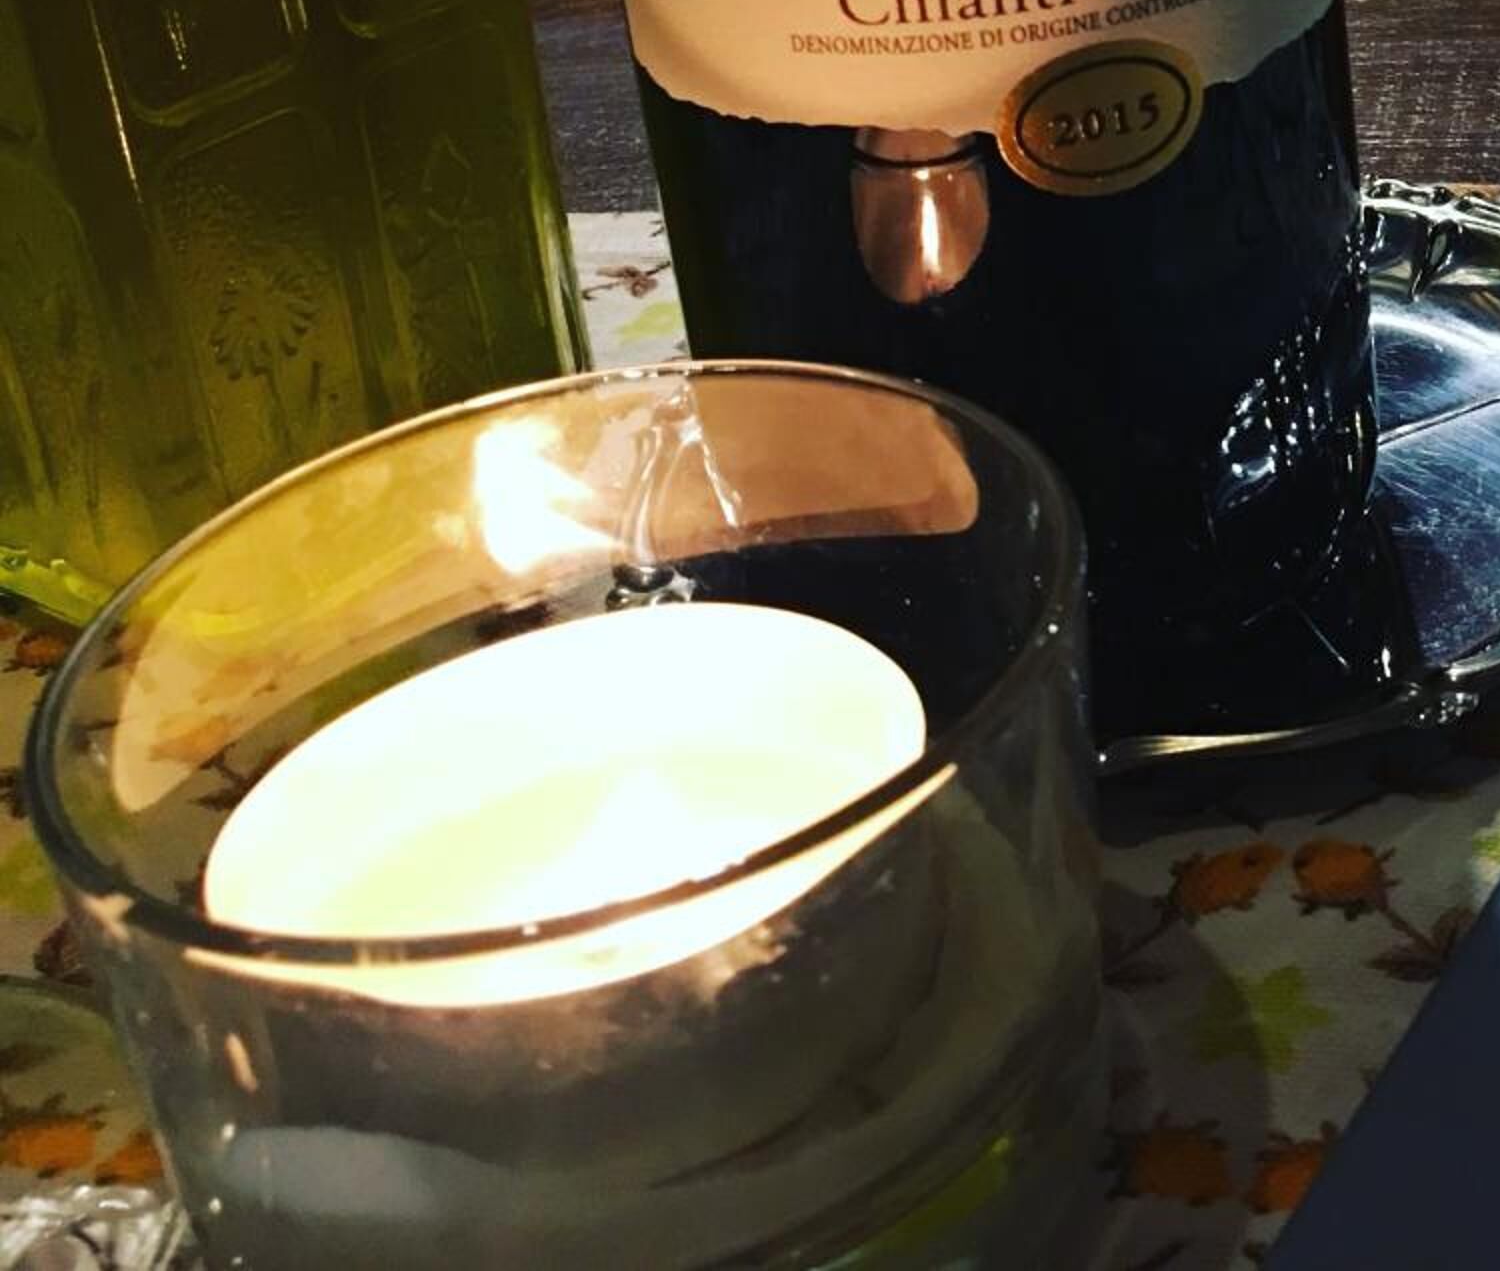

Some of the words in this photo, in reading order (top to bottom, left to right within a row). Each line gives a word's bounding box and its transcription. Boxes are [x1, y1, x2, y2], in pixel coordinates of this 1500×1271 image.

[791, 32, 974, 56] DENOMINAZIONE
[979, 27, 1002, 50] DI
[1010, 10, 1101, 44] ORIGINE
[1052, 91, 1160, 147] 2015
